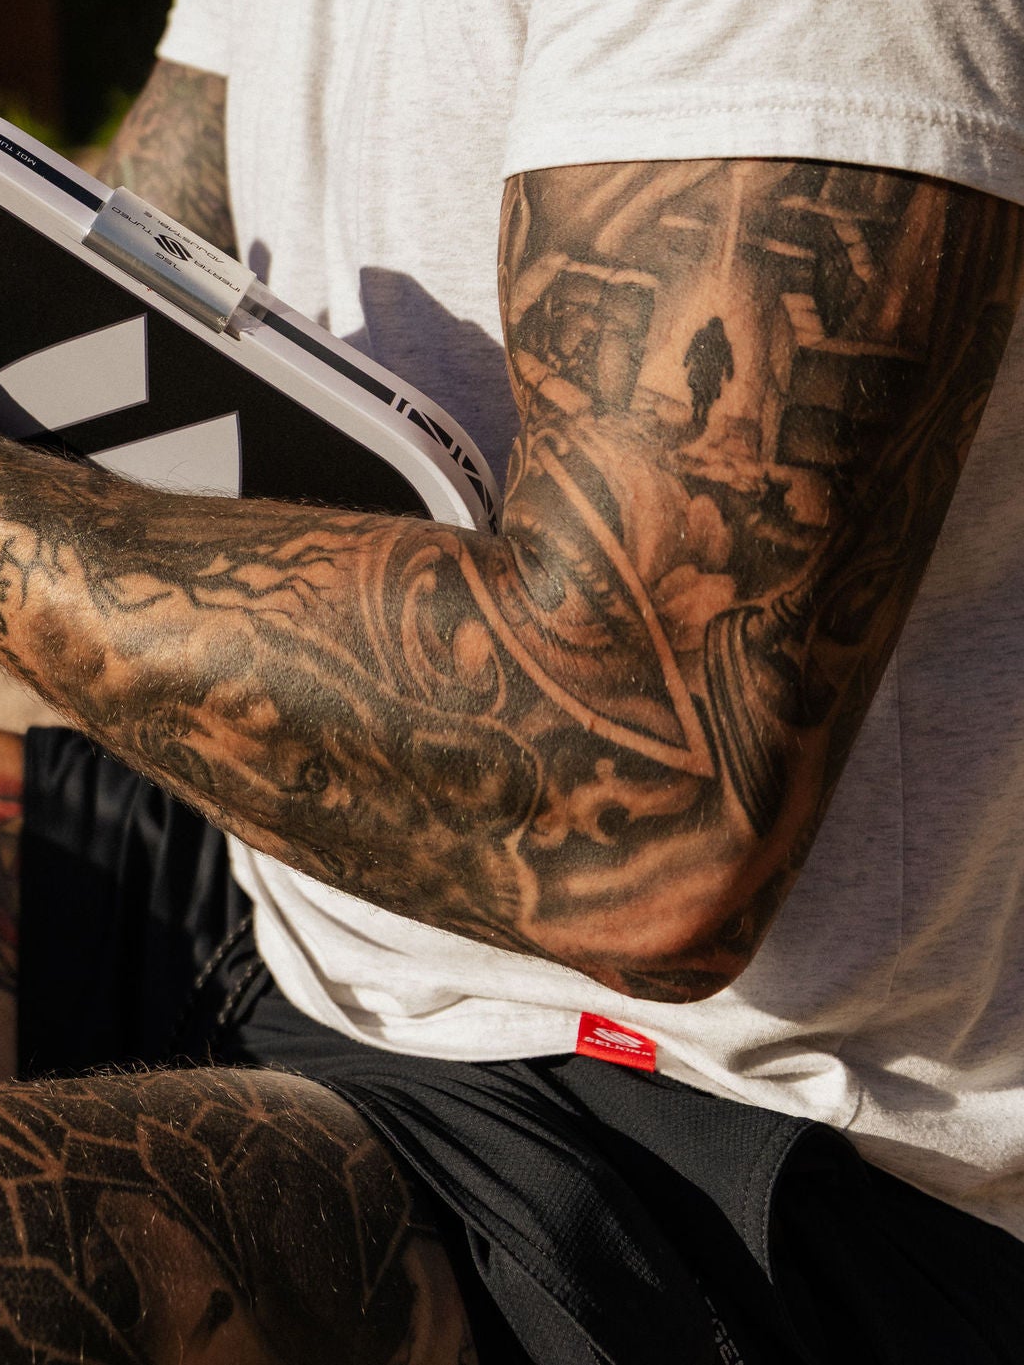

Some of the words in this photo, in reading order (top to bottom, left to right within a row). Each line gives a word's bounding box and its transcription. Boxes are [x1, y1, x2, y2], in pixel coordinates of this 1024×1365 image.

[16, 151, 36, 166] MOI
[111, 206, 153, 236] TUNED
[144, 210, 224, 264] ADJUSTABLE
[193, 260, 241, 293] INERTIA
